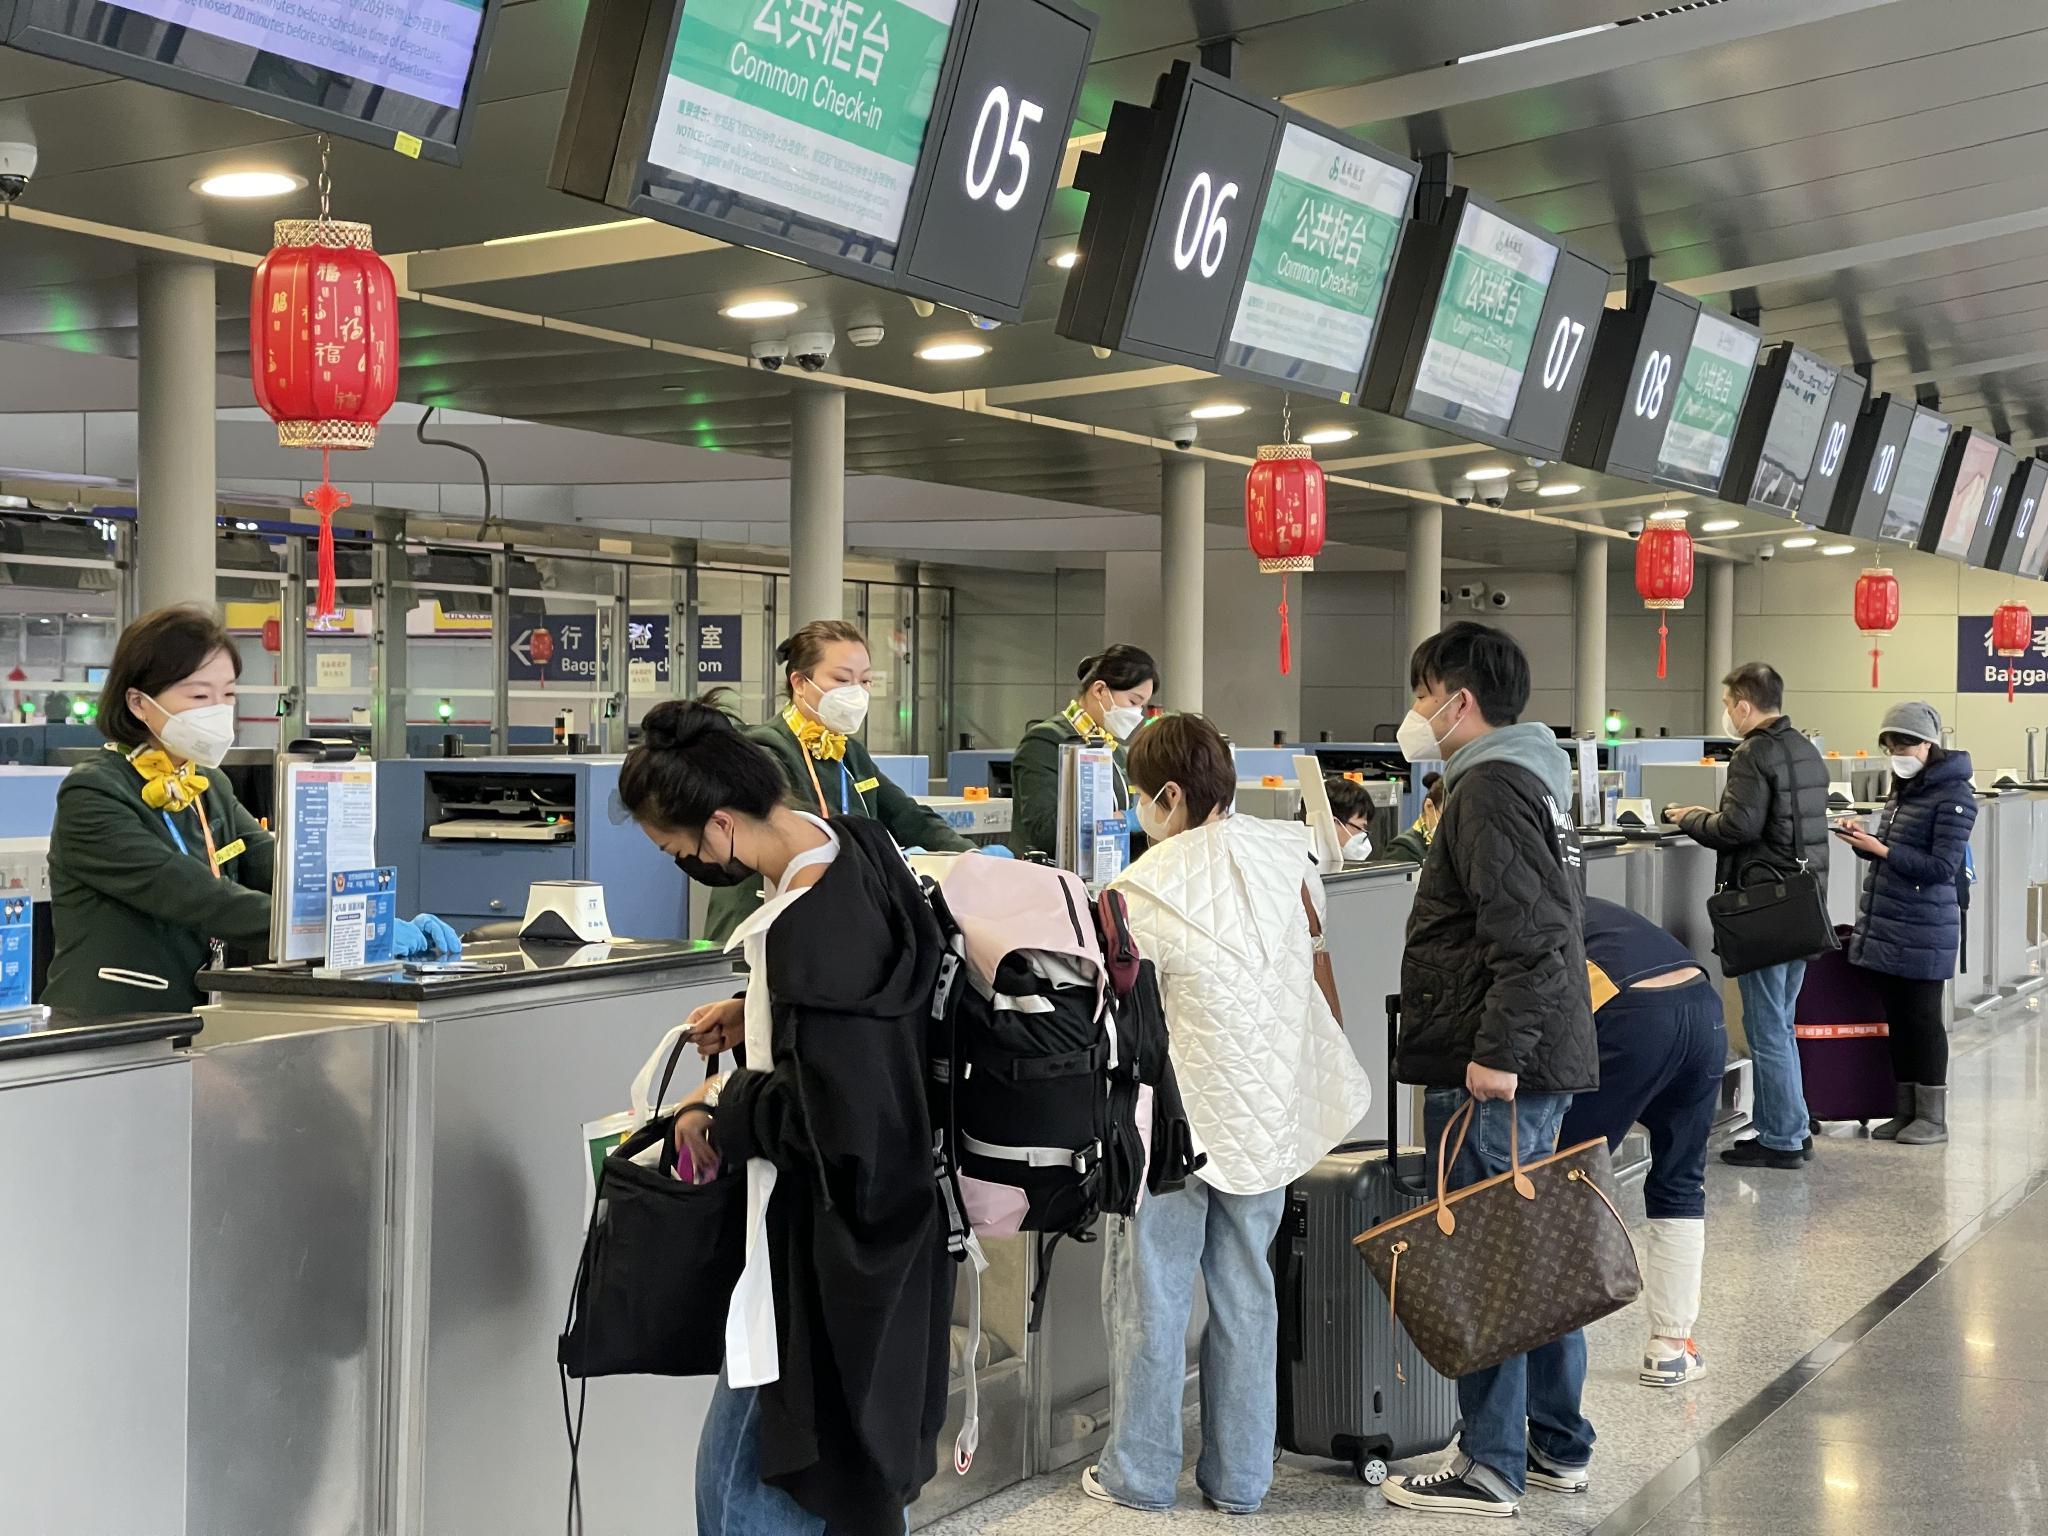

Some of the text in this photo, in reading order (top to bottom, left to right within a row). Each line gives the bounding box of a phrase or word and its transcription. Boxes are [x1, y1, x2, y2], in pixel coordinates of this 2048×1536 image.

[232, 5, 246, 20] 20
[246, 11, 285, 34] minutes
[286, 22, 317, 43] before
[317, 32, 357, 57] schedule
[328, 13, 368, 39] schedule
[730, 42, 883, 131] Common Check-in
[966, 85, 1044, 211] 05
[1174, 172, 1238, 278] 06
[1291, 197, 1367, 267] 公共柜台
[1277, 251, 1320, 287] Common
[1466, 267, 1523, 328] 公共柜台
[315, 342, 345, 367] 福
[1543, 316, 1585, 392] 07
[1635, 350, 1671, 420] 08
[1820, 421, 1847, 477] 09
[1873, 445, 1896, 495] 10
[1985, 665, 2048, 687] Bagga
